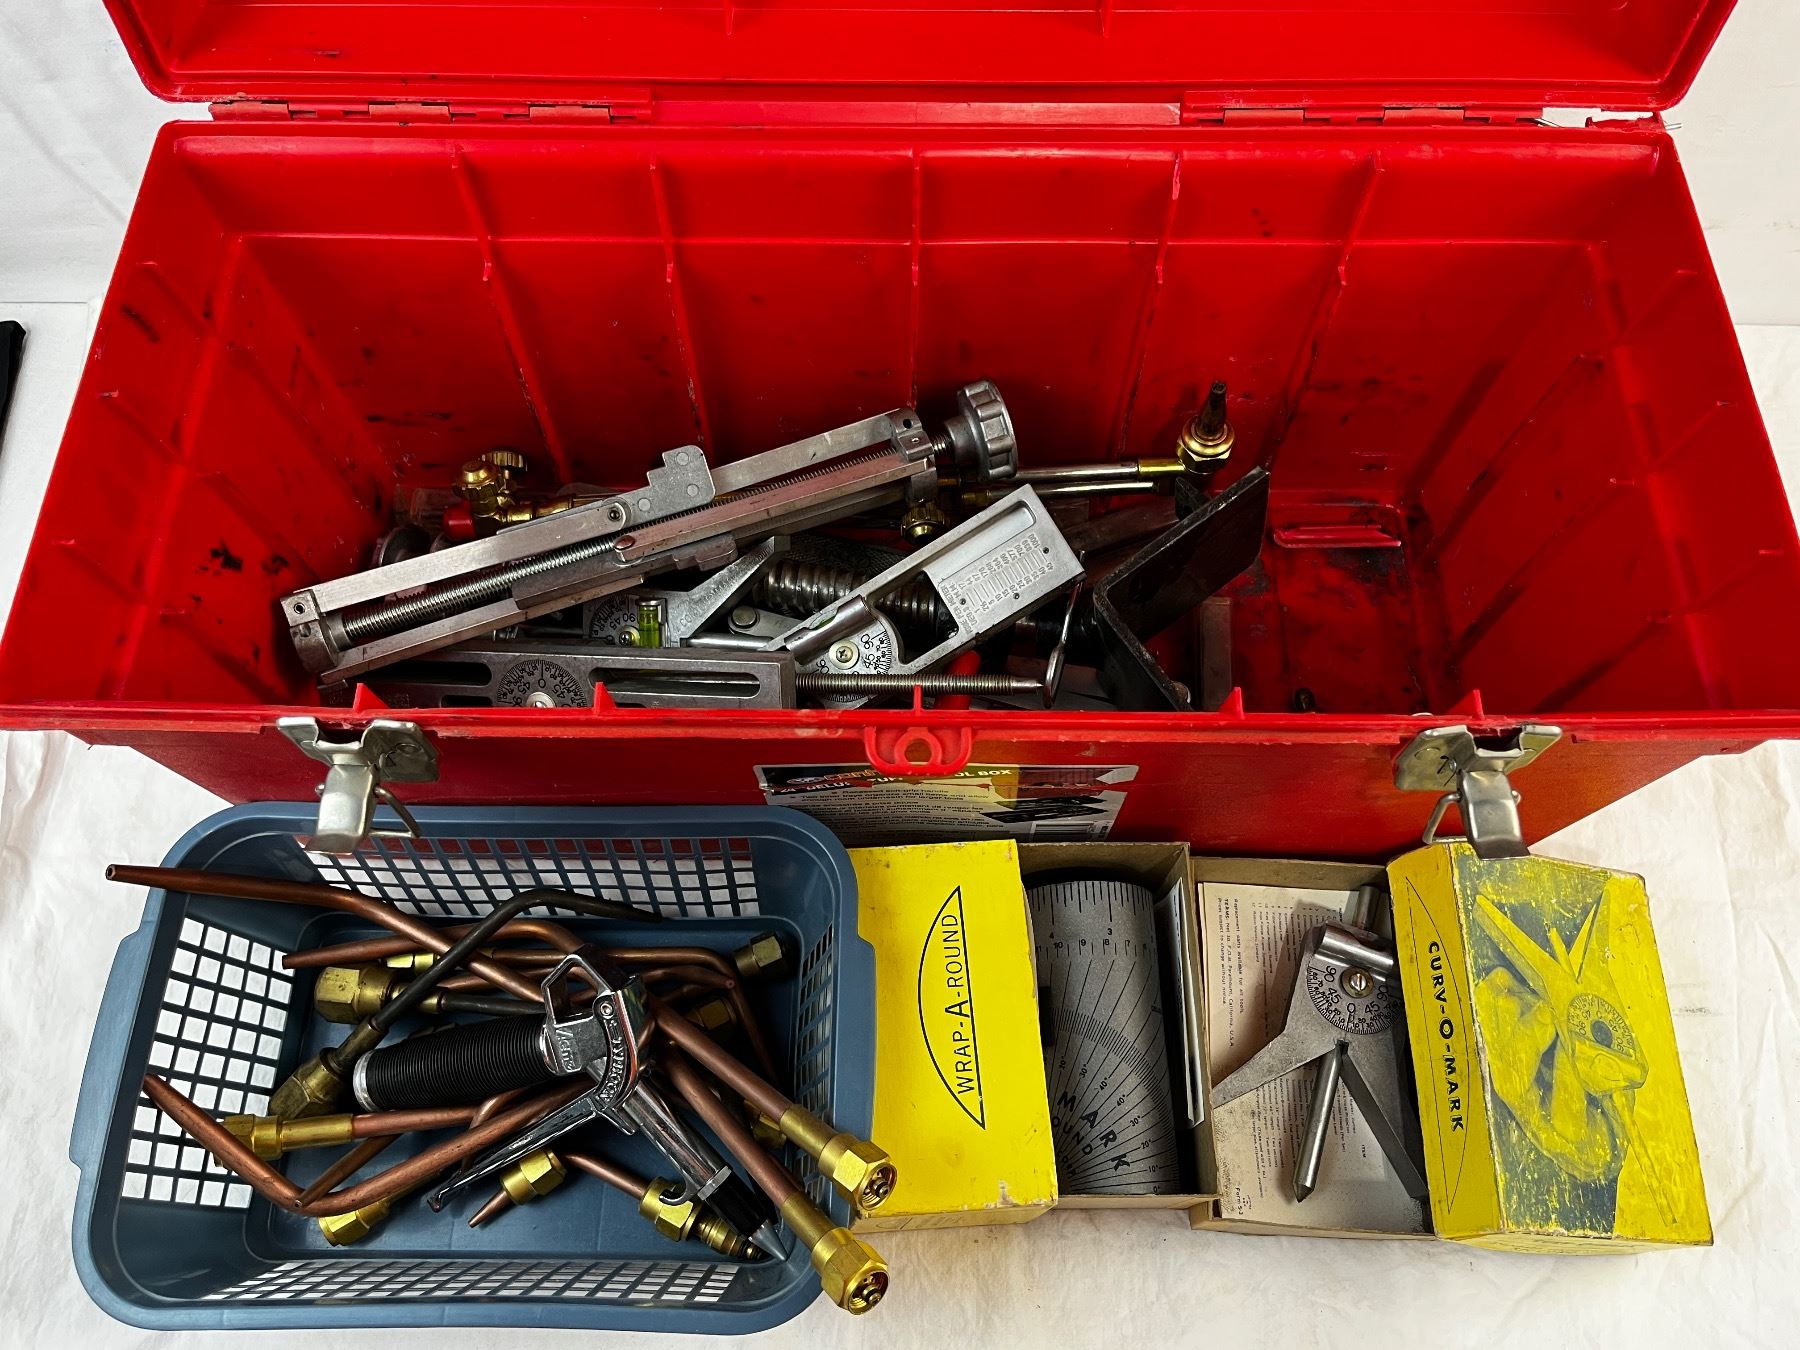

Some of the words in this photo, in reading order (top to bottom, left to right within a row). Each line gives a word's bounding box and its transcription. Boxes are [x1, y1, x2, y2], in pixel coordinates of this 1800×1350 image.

[1039, 567, 1046, 575] 40
[1010, 585, 1018, 593] 20
[1017, 580, 1025, 588] 25
[610, 617, 620, 630] 45
[623, 613, 635, 622] 90
[861, 634, 874, 649] 90
[864, 654, 875, 668] 45
[518, 682, 530, 694] 45
[538, 679, 546, 688] 0
[552, 684, 565, 698] 45
[1324, 966, 1336, 982] 90
[1328, 988, 1342, 1003] 45
[1377, 985, 1388, 1001] 90
[942, 914, 975, 1094] WRAP-A-ROUND
[1347, 1003, 1355, 1013] 0
[1365, 1001, 1379, 1014] 45
[1582, 1010, 1590, 1020] 45
[1579, 1021, 1586, 1035] 90
[1609, 1019, 1618, 1032] 45
[1427, 940, 1464, 1132] CURV-O-MARK
[1616, 1037, 1624, 1051] 90
[1099, 1077, 1108, 1091] 40°
[1116, 1094, 1126, 1106] 40°
[1130, 1115, 1141, 1127] 30°
[1141, 1139, 1151, 1149] 20°
[1148, 1164, 1158, 1172] 10°
